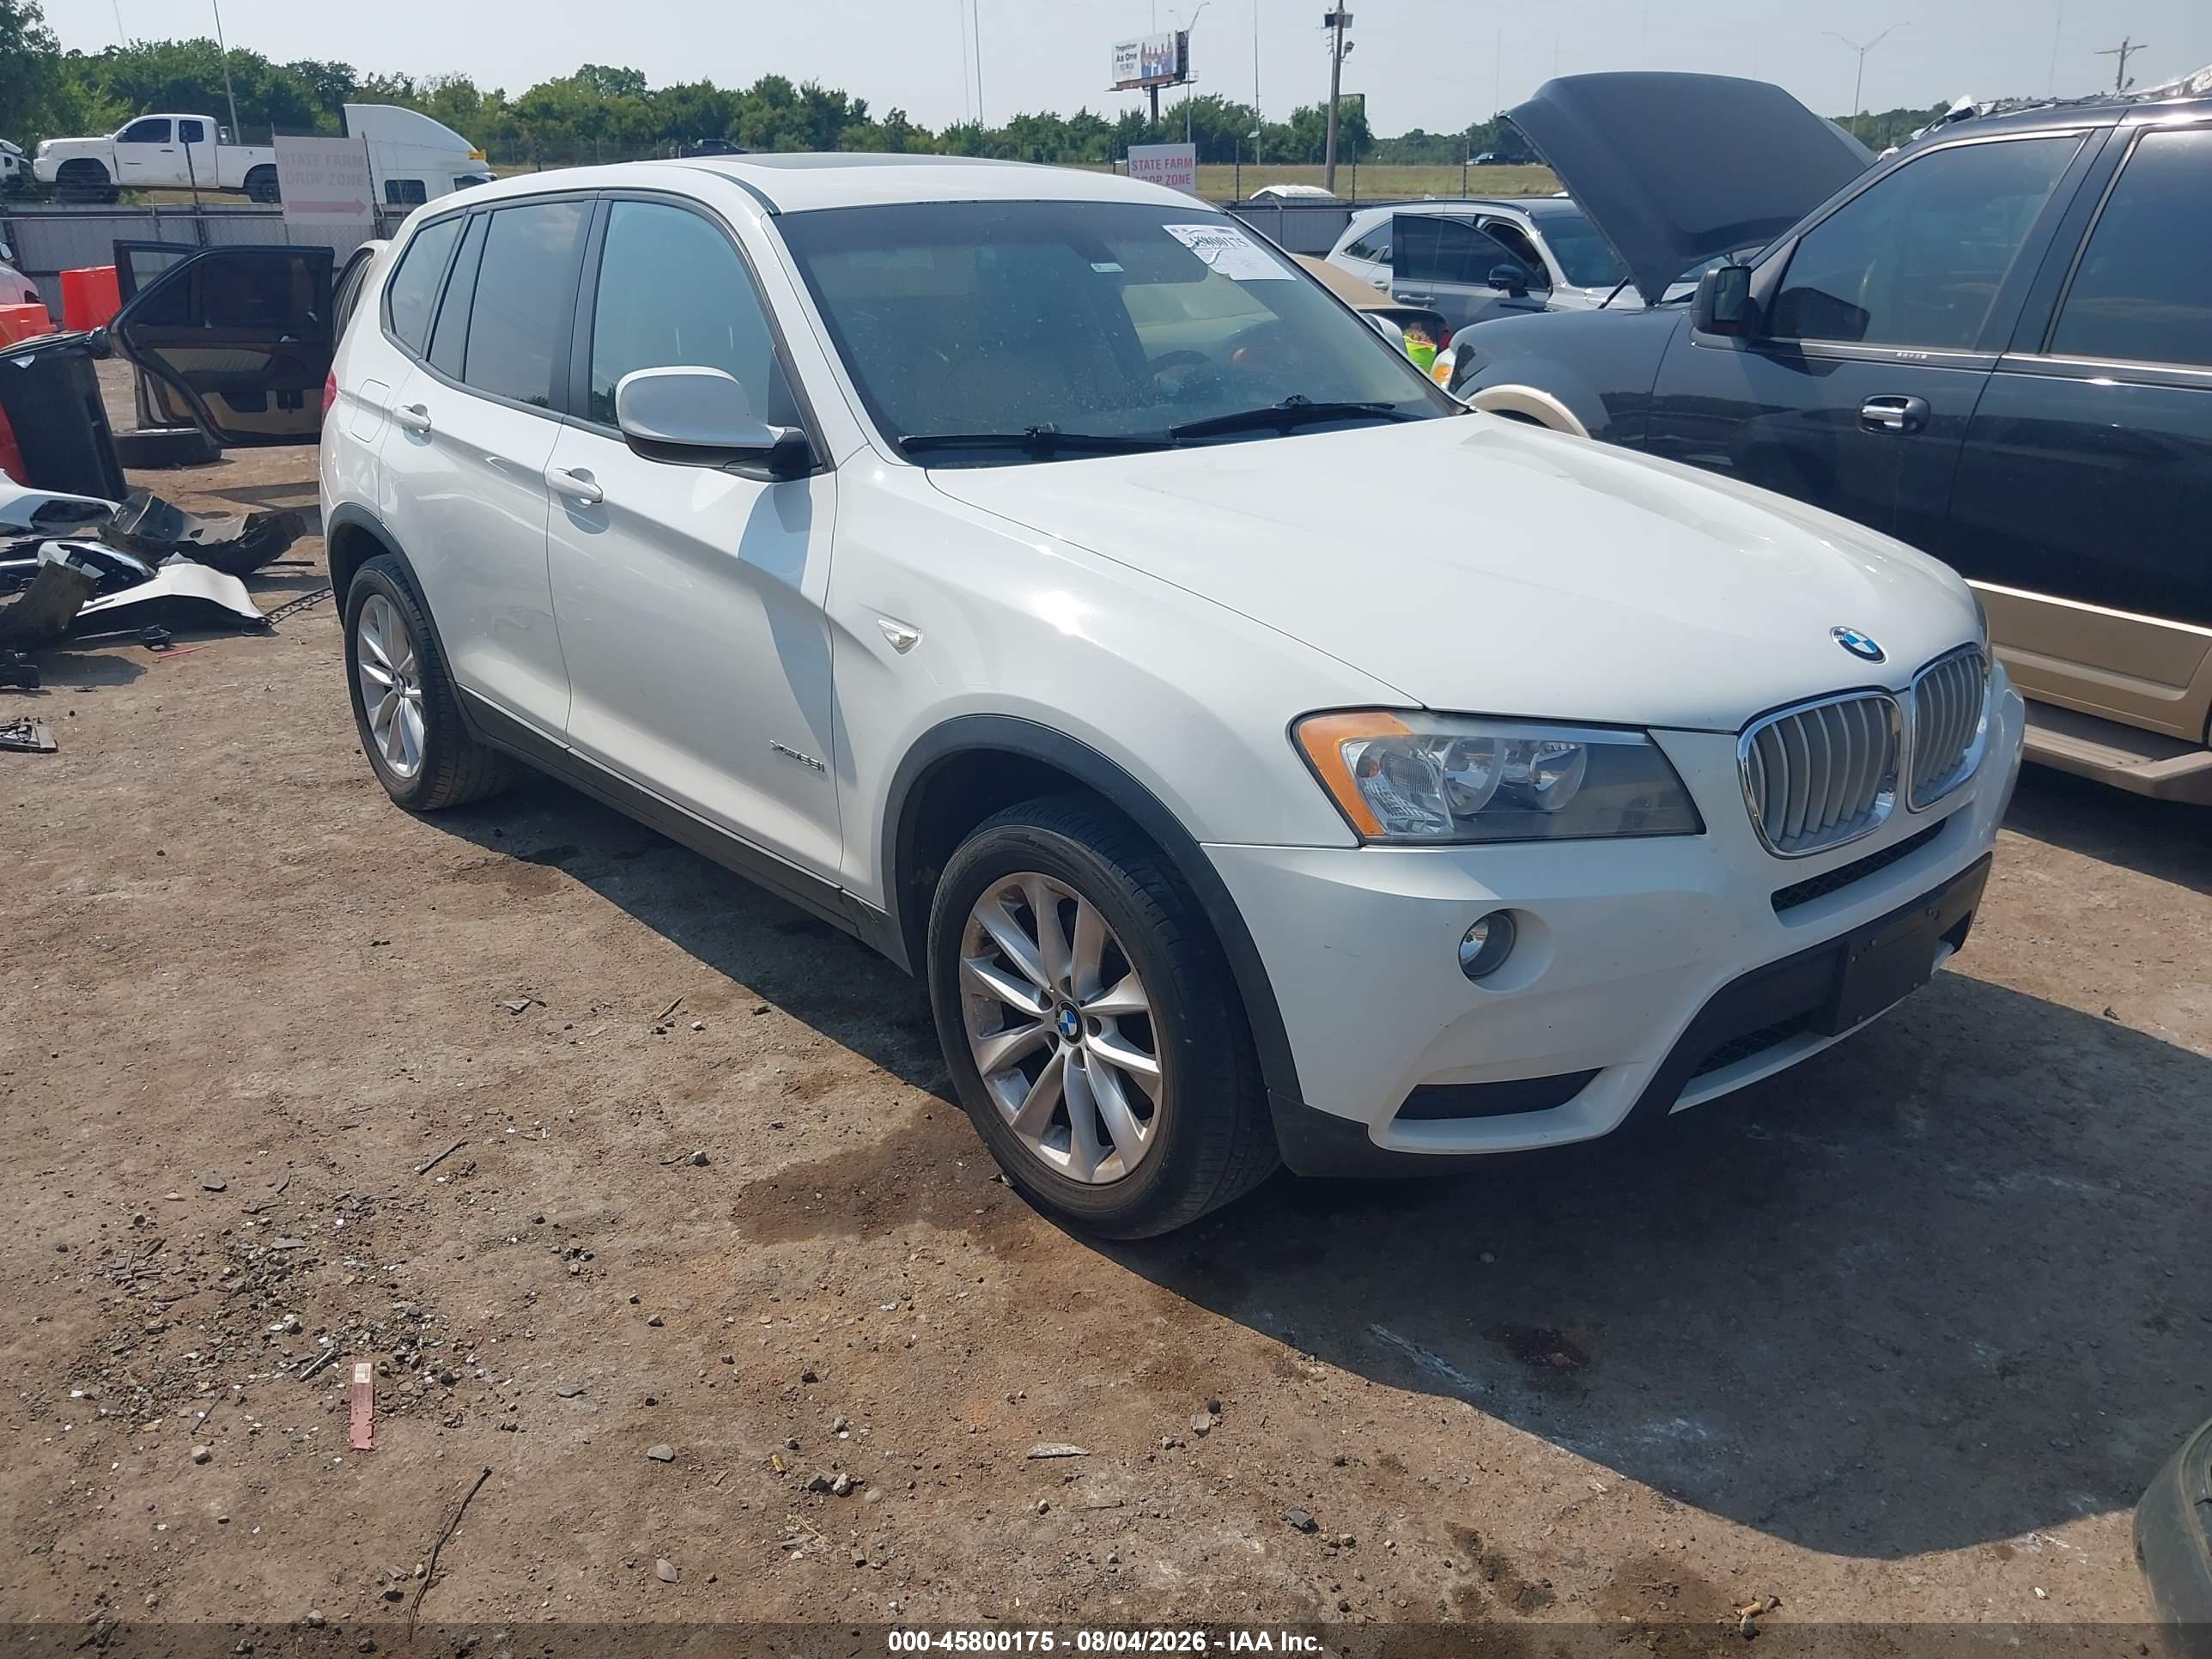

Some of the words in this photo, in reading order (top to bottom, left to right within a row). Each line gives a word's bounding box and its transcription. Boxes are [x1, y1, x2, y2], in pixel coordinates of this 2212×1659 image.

[280, 152, 321, 166] STATE
[325, 154, 365, 167] FARM
[1132, 159, 1162, 172] STATE
[1164, 157, 1193, 170] FARM
[285, 172, 324, 186] DROP
[330, 173, 365, 186] ZONE
[1166, 173, 1191, 186] ZONE
